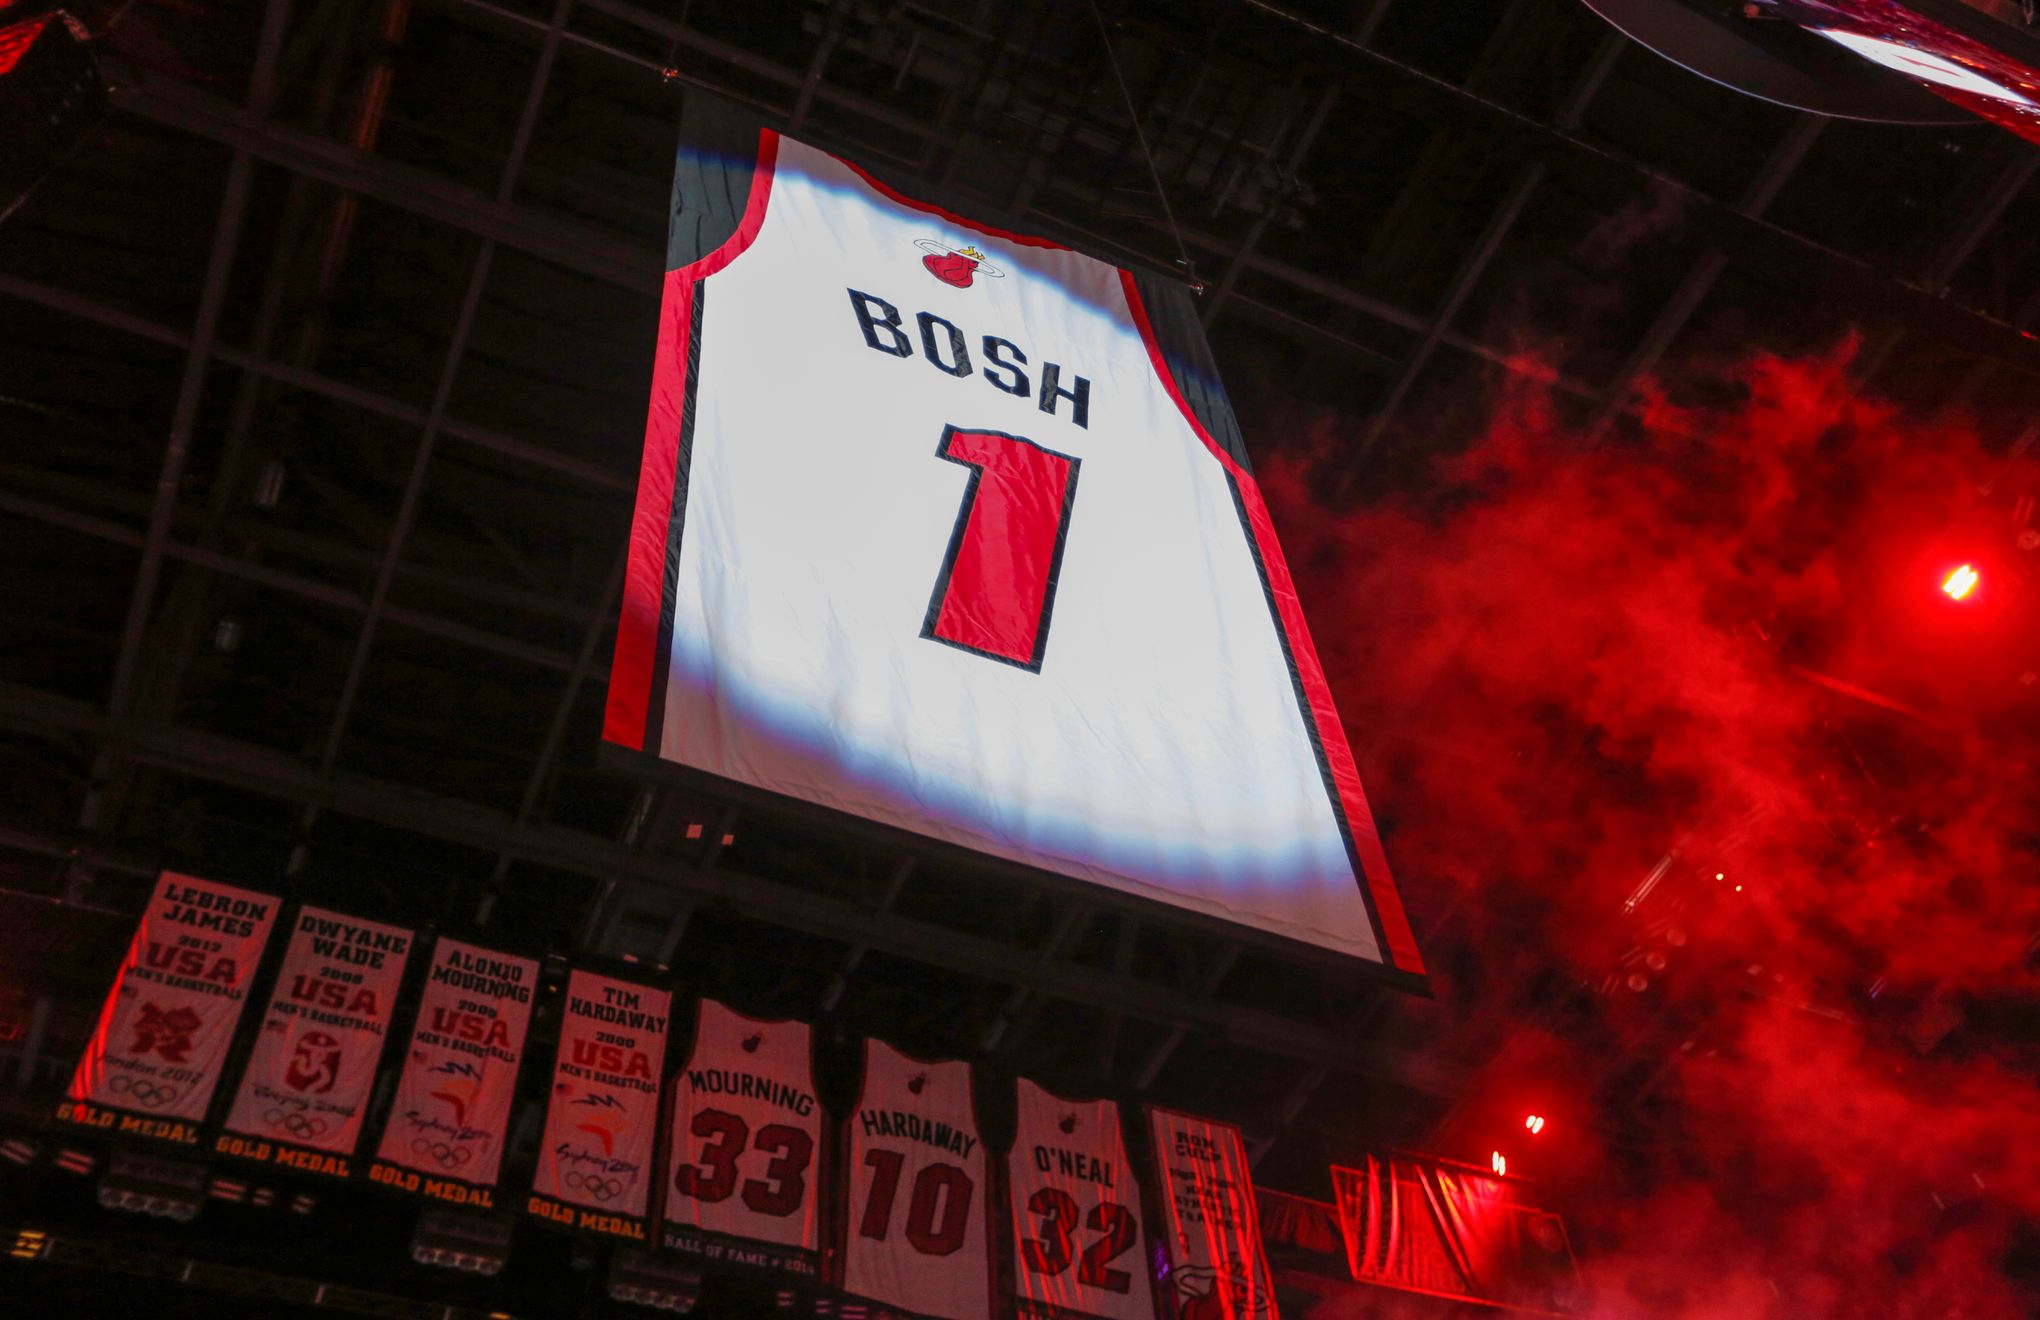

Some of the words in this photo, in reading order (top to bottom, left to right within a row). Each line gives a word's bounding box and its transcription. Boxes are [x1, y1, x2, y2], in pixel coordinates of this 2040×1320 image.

[846, 287, 1091, 430] BOSH
[918, 423, 1082, 675] 1
[163, 905, 255, 937] JAMES
[164, 883, 268, 921] LEBRON
[179, 935, 222, 952] 2012
[300, 915, 407, 954] DWYANE
[312, 937, 386, 970] WADE
[146, 942, 237, 983] USA
[320, 967, 364, 984] 2008
[447, 950, 523, 982] ALONZO
[127, 966, 163, 983] MEN'S
[165, 974, 243, 1000] BASKETBALL
[290, 975, 378, 1016] USA
[431, 965, 530, 1004] MOURNING
[603, 986, 641, 1010] TIM
[272, 1001, 308, 1020] MEN'S
[309, 1009, 385, 1035] BASKETBALL
[433, 1007, 510, 1047] USA
[457, 999, 498, 1019] 2000
[569, 996, 666, 1034] HARDAWAY
[416, 1031, 449, 1049] MEN'S
[450, 1039, 516, 1063] BASKETBALL
[572, 1038, 652, 1079] USA
[595, 1031, 636, 1048] 2000
[559, 1062, 592, 1080] MEN'S
[593, 1070, 657, 1095] BASKETBALL
[688, 1069, 814, 1117] MOURNING
[55, 1102, 116, 1128] GOLD
[119, 1115, 199, 1144] MEDAL
[860, 1109, 977, 1160] HARDAWAY
[215, 1135, 271, 1161] GOLD
[275, 1146, 350, 1177] MEDAL
[674, 1107, 813, 1218] 33
[1034, 1145, 1114, 1188] O'NEAL
[369, 1163, 419, 1193] GOLD
[424, 1180, 494, 1208] MEDAL
[859, 1148, 975, 1257] 10
[527, 1197, 576, 1224] GOLD
[579, 1211, 646, 1240] MEDAL
[663, 1233, 701, 1253] HALL
[705, 1244, 724, 1259] OF
[727, 1248, 768, 1266] FAME
[1021, 1187, 1137, 1295] 32
